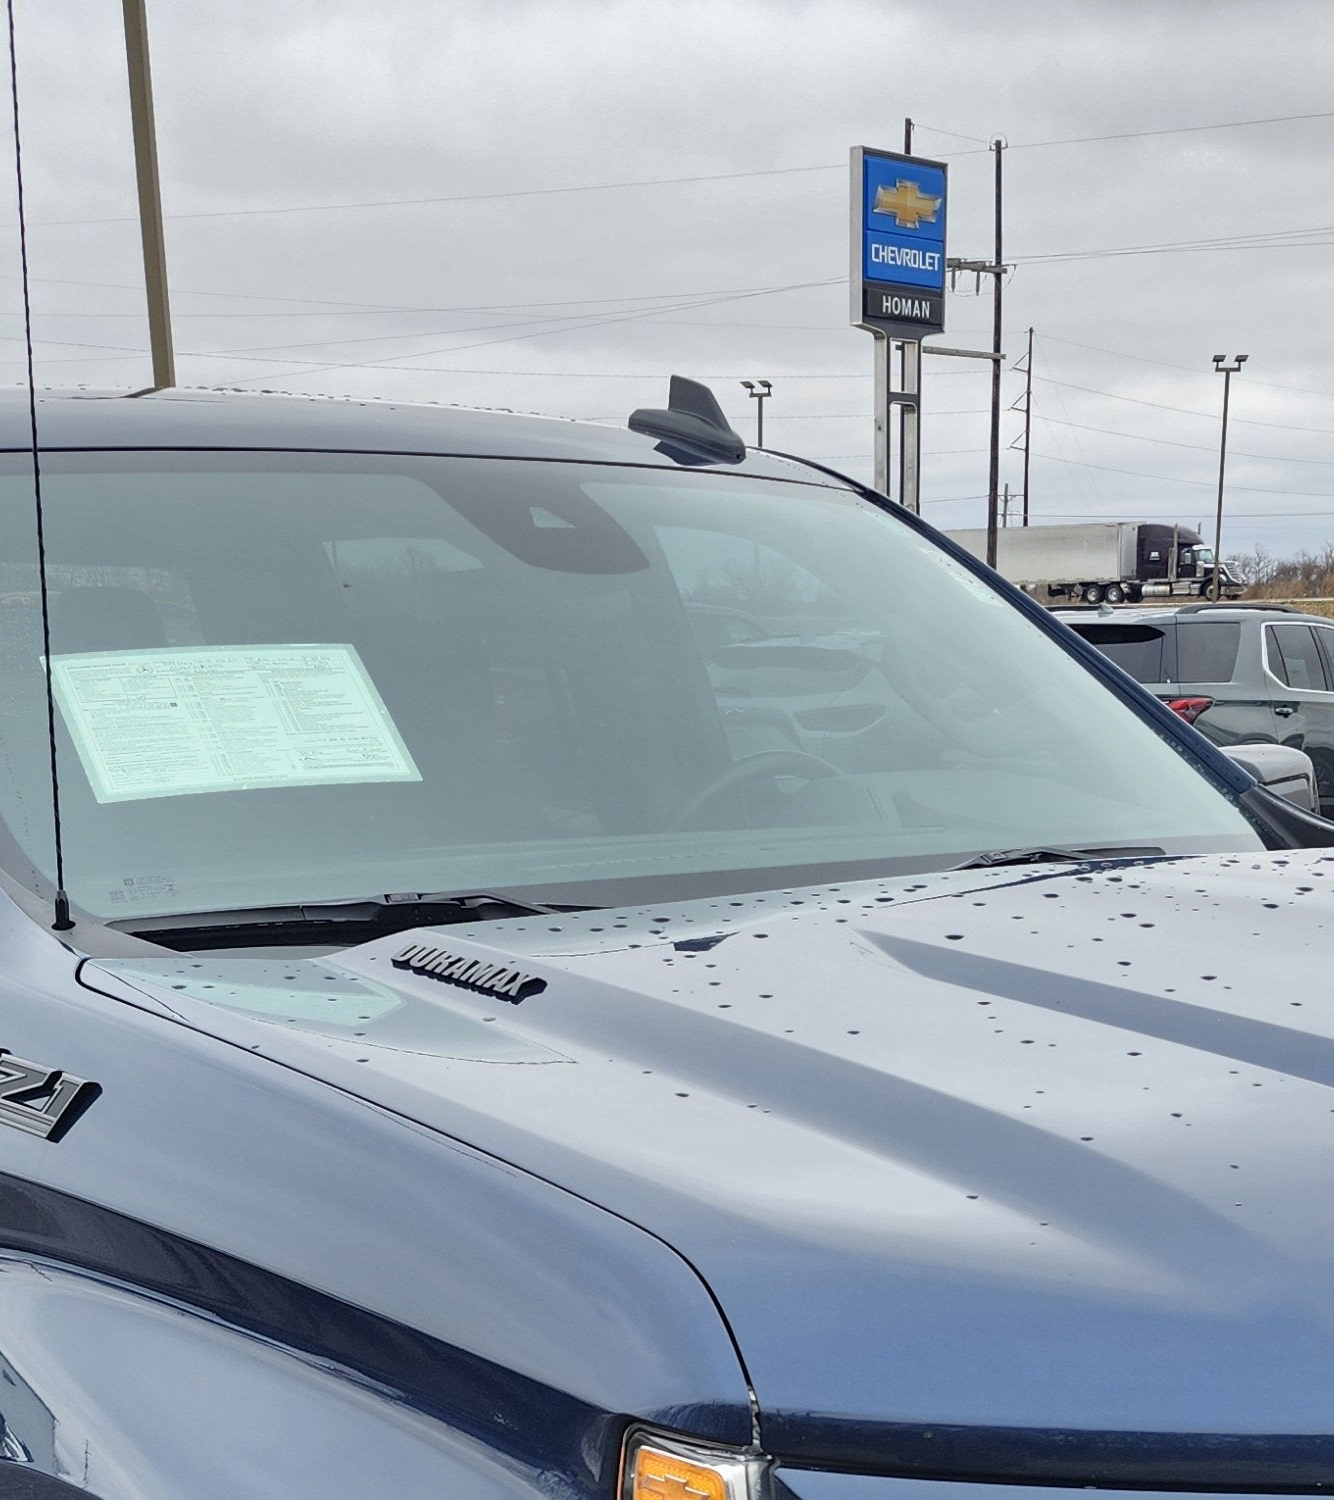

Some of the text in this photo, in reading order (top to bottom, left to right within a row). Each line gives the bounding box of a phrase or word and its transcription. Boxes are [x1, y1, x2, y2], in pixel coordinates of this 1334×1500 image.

[871, 243, 940, 271] CHEVROLET
[882, 295, 930, 319] HOMAN
[391, 943, 531, 998] DURAMAX
